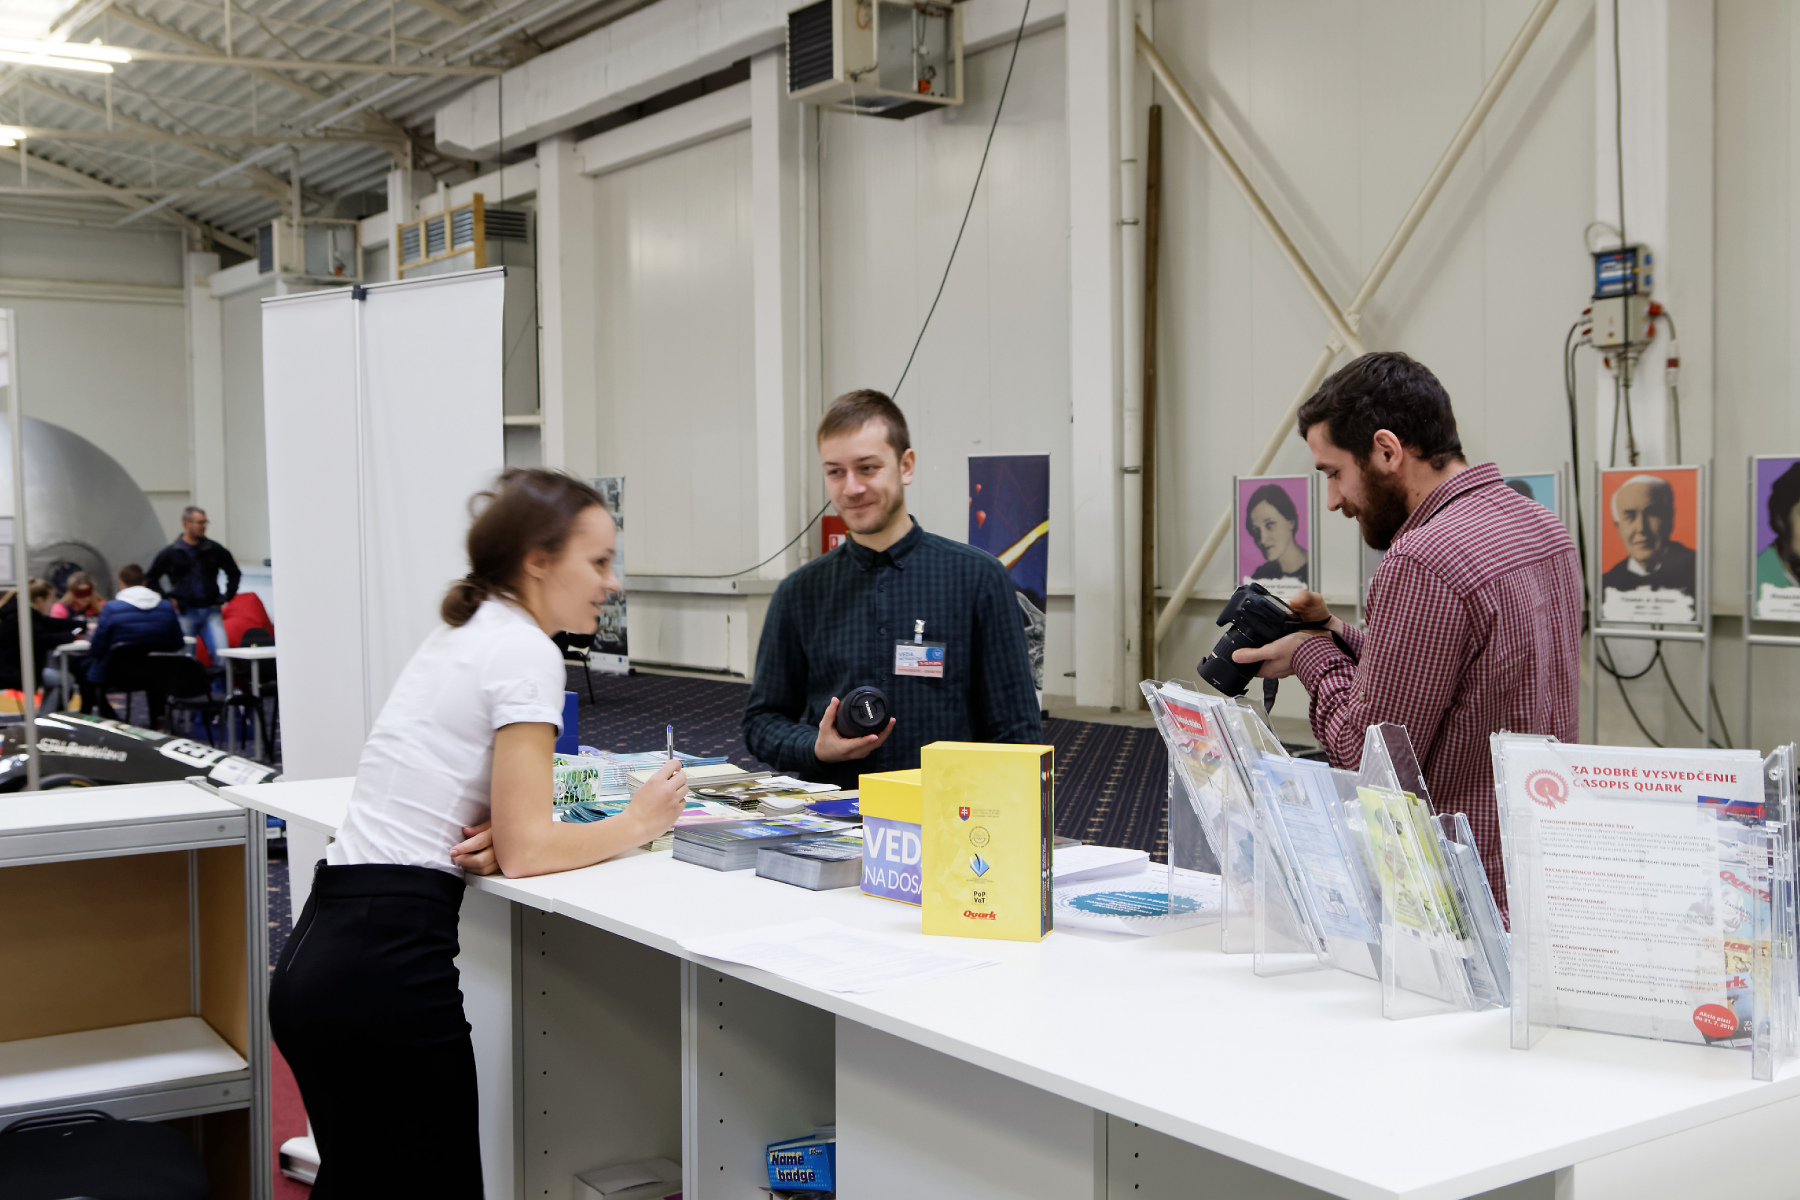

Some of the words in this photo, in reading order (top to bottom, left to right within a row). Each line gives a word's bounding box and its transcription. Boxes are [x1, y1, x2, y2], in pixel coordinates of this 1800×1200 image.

[1571, 765, 1589, 777] ZA
[1593, 767, 1639, 777] DOBRÉ
[1642, 769, 1737, 783] VYSVEDČENIE
[1634, 782, 1683, 793] QUARK
[863, 825, 922, 866] VED
[864, 865, 886, 888] NA
[963, 910, 997, 920] Quark
[770, 1151, 805, 1166] Name
[776, 1167, 816, 1184] badge
